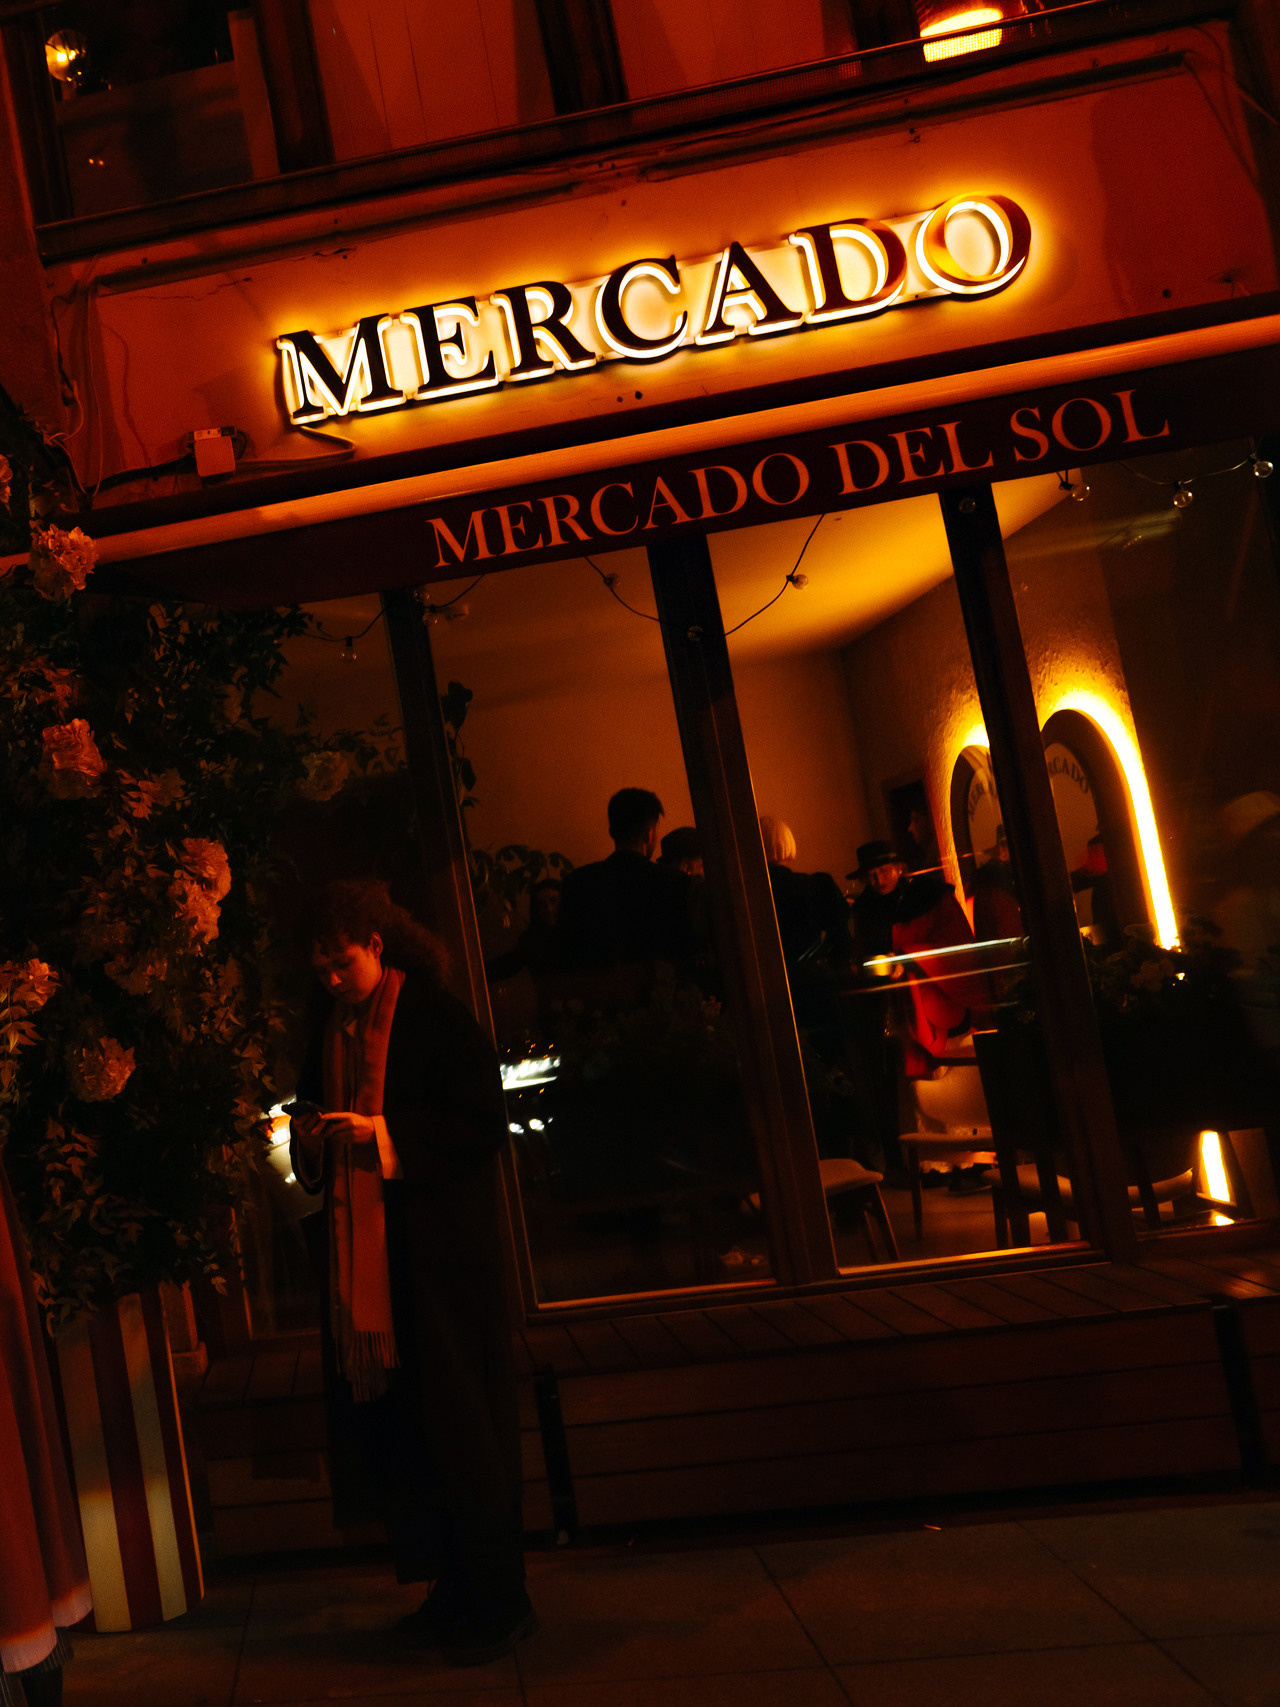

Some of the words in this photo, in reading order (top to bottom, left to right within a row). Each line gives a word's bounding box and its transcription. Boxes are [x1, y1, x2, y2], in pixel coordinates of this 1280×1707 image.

[276, 193, 1031, 425] MERCADO
[425, 452, 810, 568] MERCADO
[828, 420, 994, 495] DEL
[1009, 388, 1170, 462] SOL
